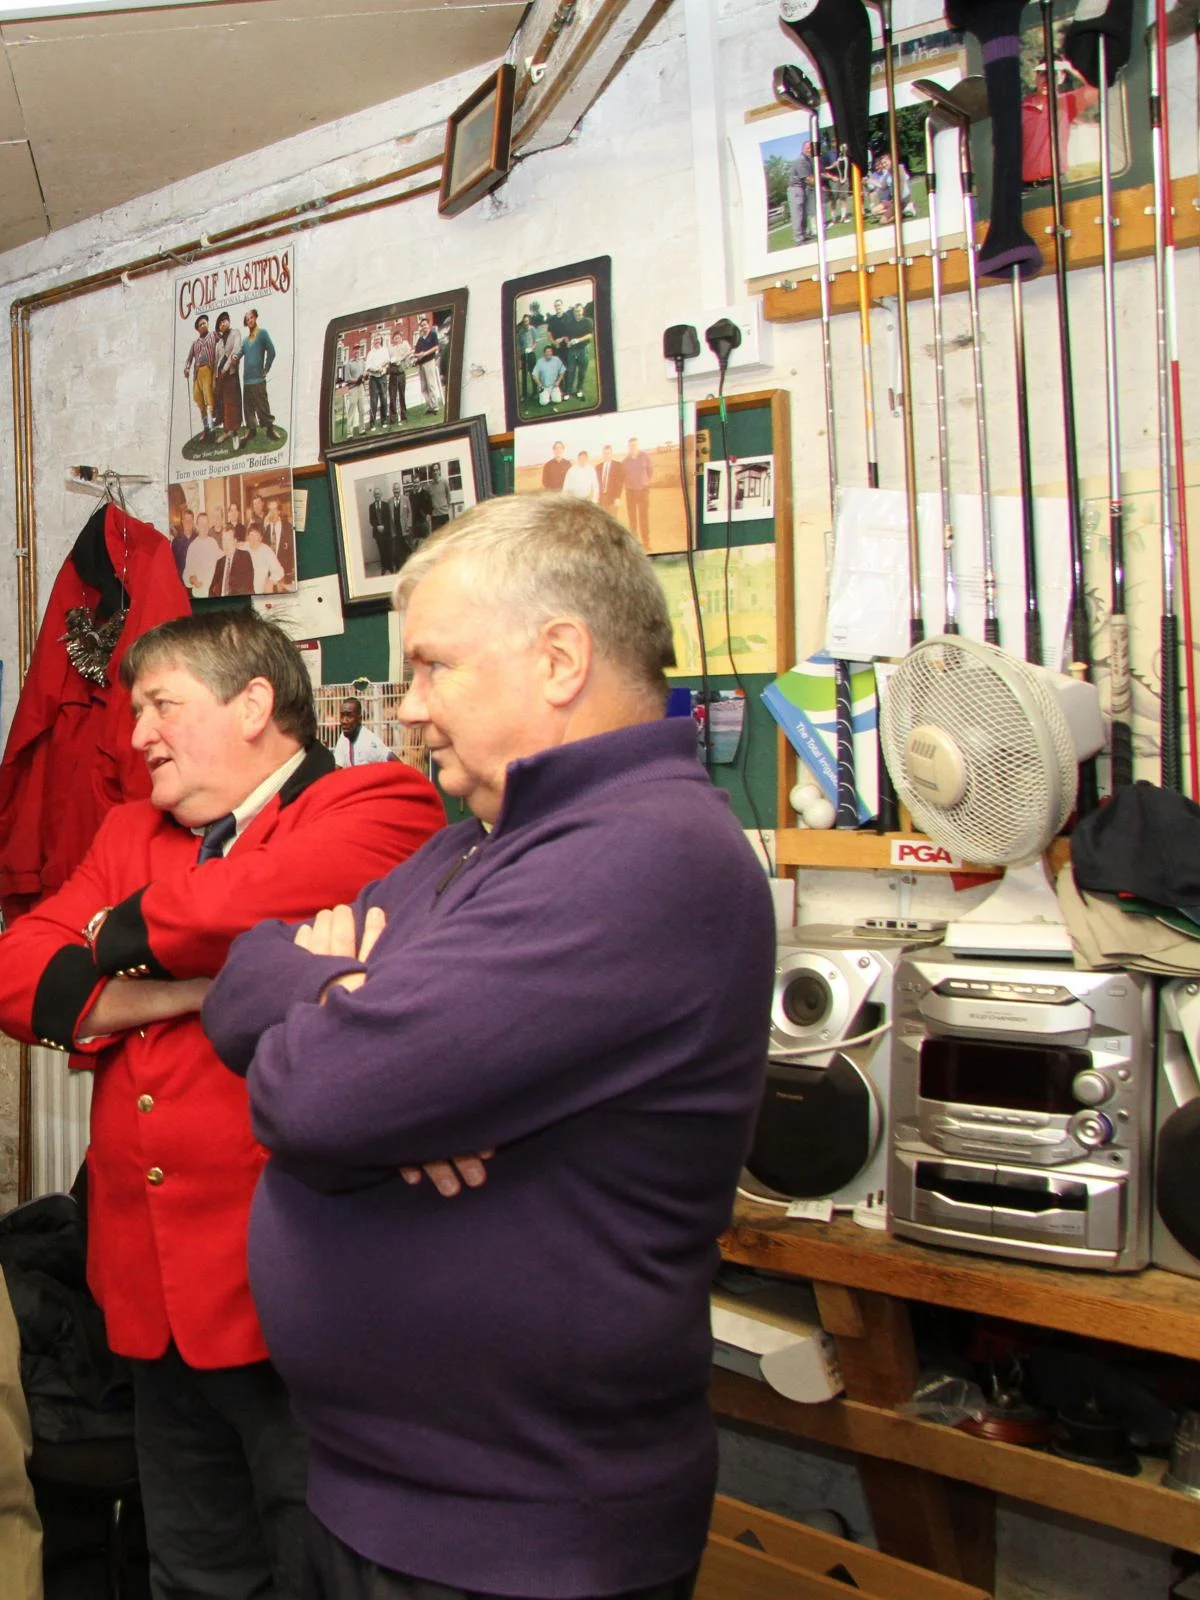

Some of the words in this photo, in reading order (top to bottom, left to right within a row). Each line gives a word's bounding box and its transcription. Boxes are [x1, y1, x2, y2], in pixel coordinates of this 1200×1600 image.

[180, 272, 219, 320] GOLF
[223, 250, 290, 296] MASTERS
[175, 470, 191, 480] Turn
[192, 469, 207, 479] your
[231, 461, 246, 471] into
[795, 721, 809, 740] The
[806, 737, 821, 758] Total
[898, 844, 953, 864] PGA
